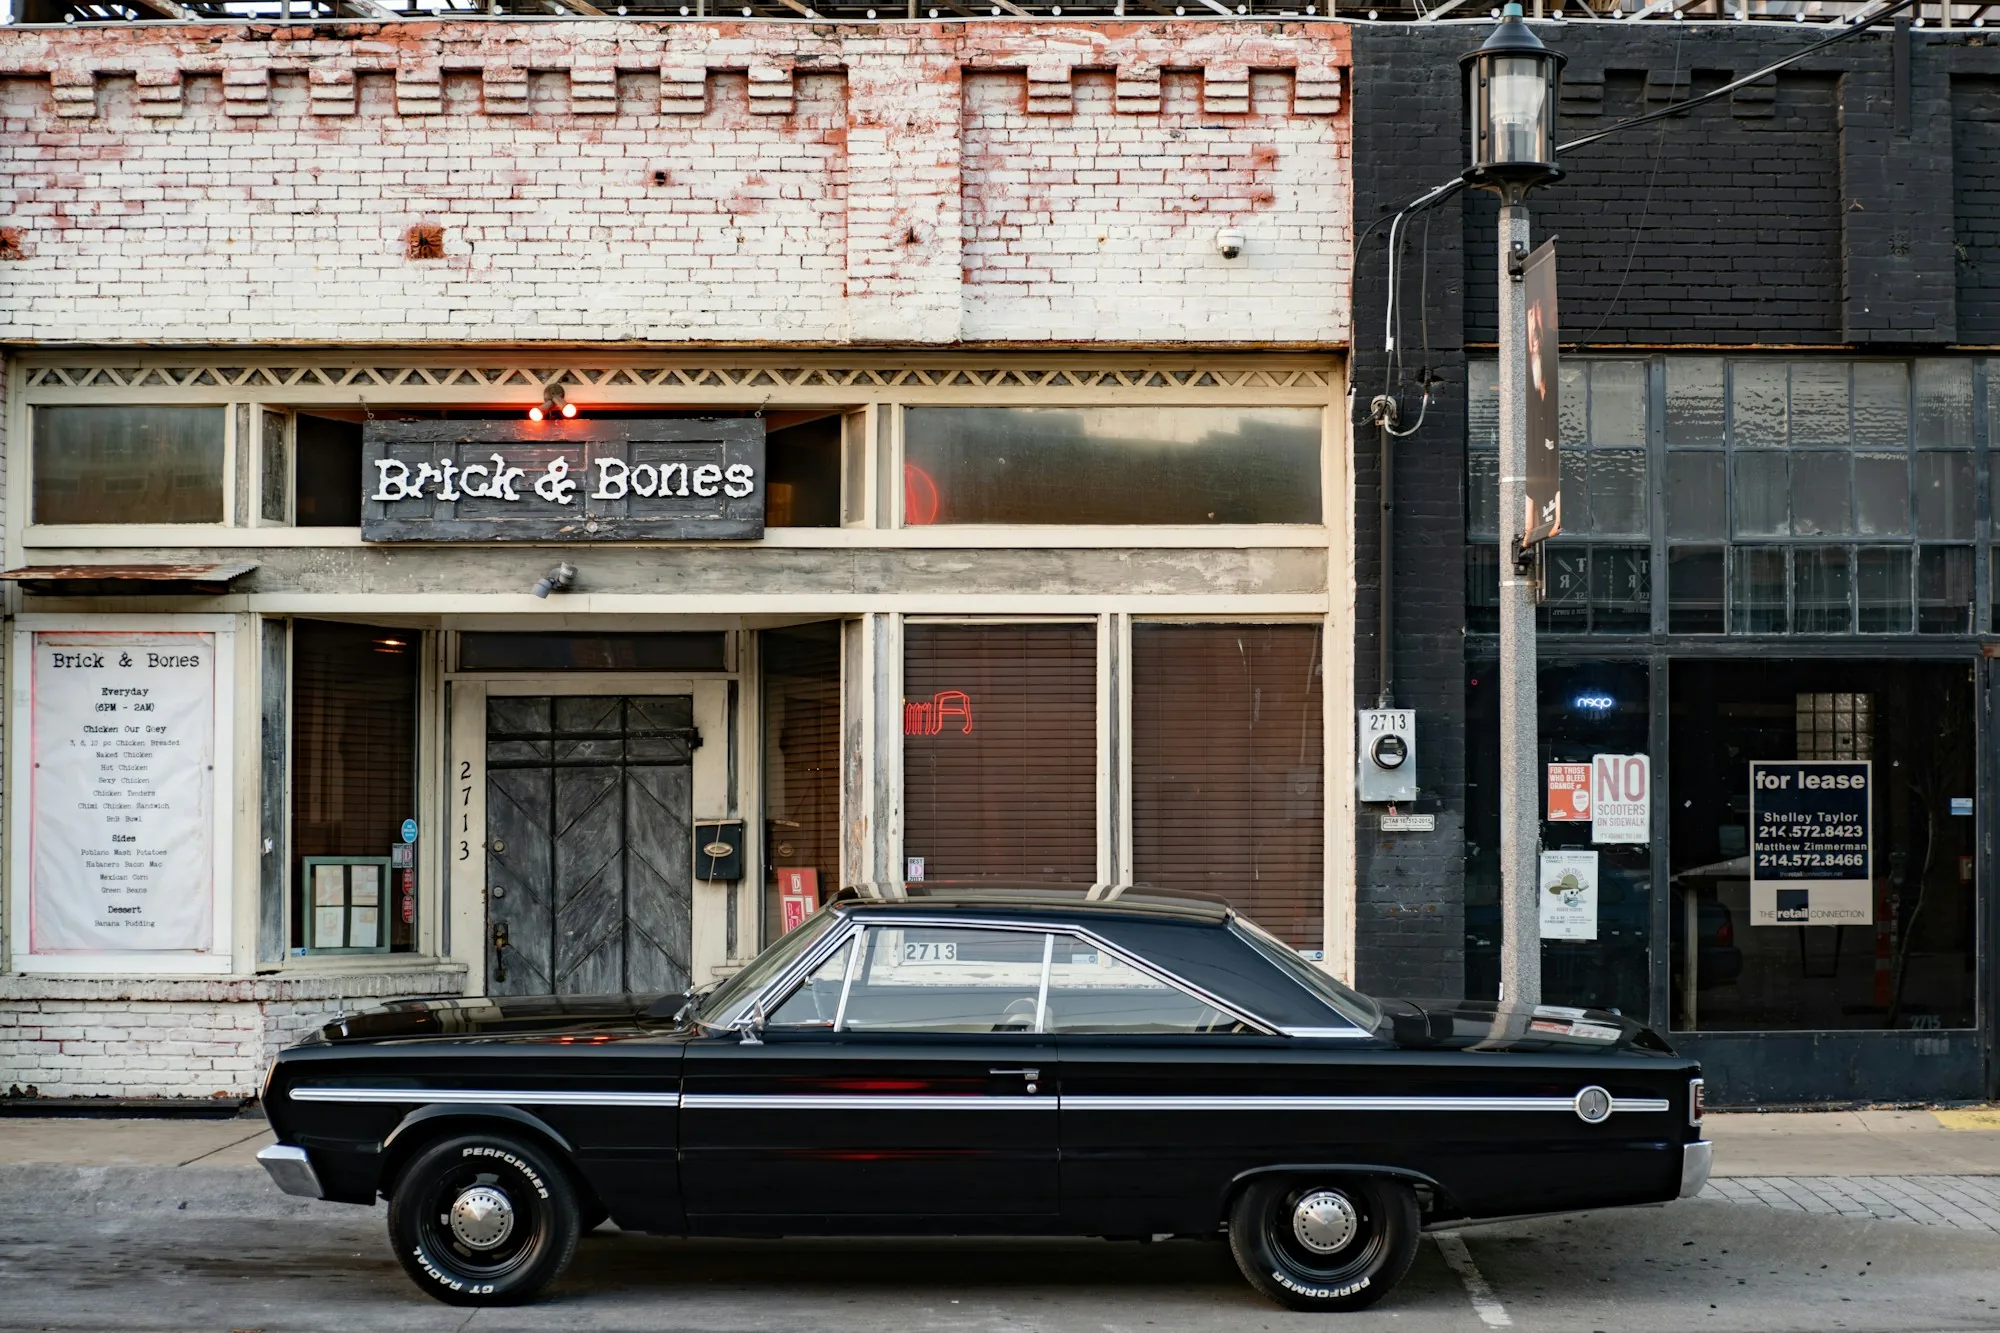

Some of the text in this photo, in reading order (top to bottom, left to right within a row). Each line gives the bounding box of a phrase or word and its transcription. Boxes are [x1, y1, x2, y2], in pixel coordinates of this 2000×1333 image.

[371, 452, 756, 505] Brick & Bones
[52, 652, 200, 668] Brick & Bones
[101, 687, 149, 697] Everyday
[94, 703, 116, 712] (6PM
[133, 703, 155, 712] 2AM)
[1370, 713, 1406, 730] 2713
[83, 725, 118, 734] Chicken
[124, 725, 140, 734] Our
[115, 739, 146, 747] Chicken
[150, 739, 180, 747] Breaded
[96, 751, 153, 759] Naked Chicken
[98, 776, 150, 785] Sexy Chicken
[1597, 758, 1645, 802] NO
[1755, 770, 1865, 790] for lease
[77, 802, 170, 810] Chimi Chicken Sandwich
[459, 761, 472, 860] 2713
[1597, 804, 1645, 816] SCOOTERS
[106, 815, 142, 823] BnB Bowl
[1597, 818, 1645, 826] ON SIDEWALK
[1764, 812, 1859, 823] Shelley Taylor
[111, 834, 136, 843] Sides
[1755, 843, 1867, 851] Matthew Zimmerman
[86, 860, 163, 868] Habanero Bacon Mac
[1759, 854, 1863, 867] 214.572.8466
[99, 873, 149, 881] Mexican Corn
[101, 886, 147, 894] Green Beans
[107, 905, 142, 914] Dessert
[1777, 908, 1808, 919] retail
[125, 920, 156, 928] Pudding
[906, 944, 955, 960] 2713
[462, 1147, 549, 1199] PERFORMER
[412, 1246, 494, 1294] GT RADIAL
[1272, 1271, 1371, 1298] PERFORMER
